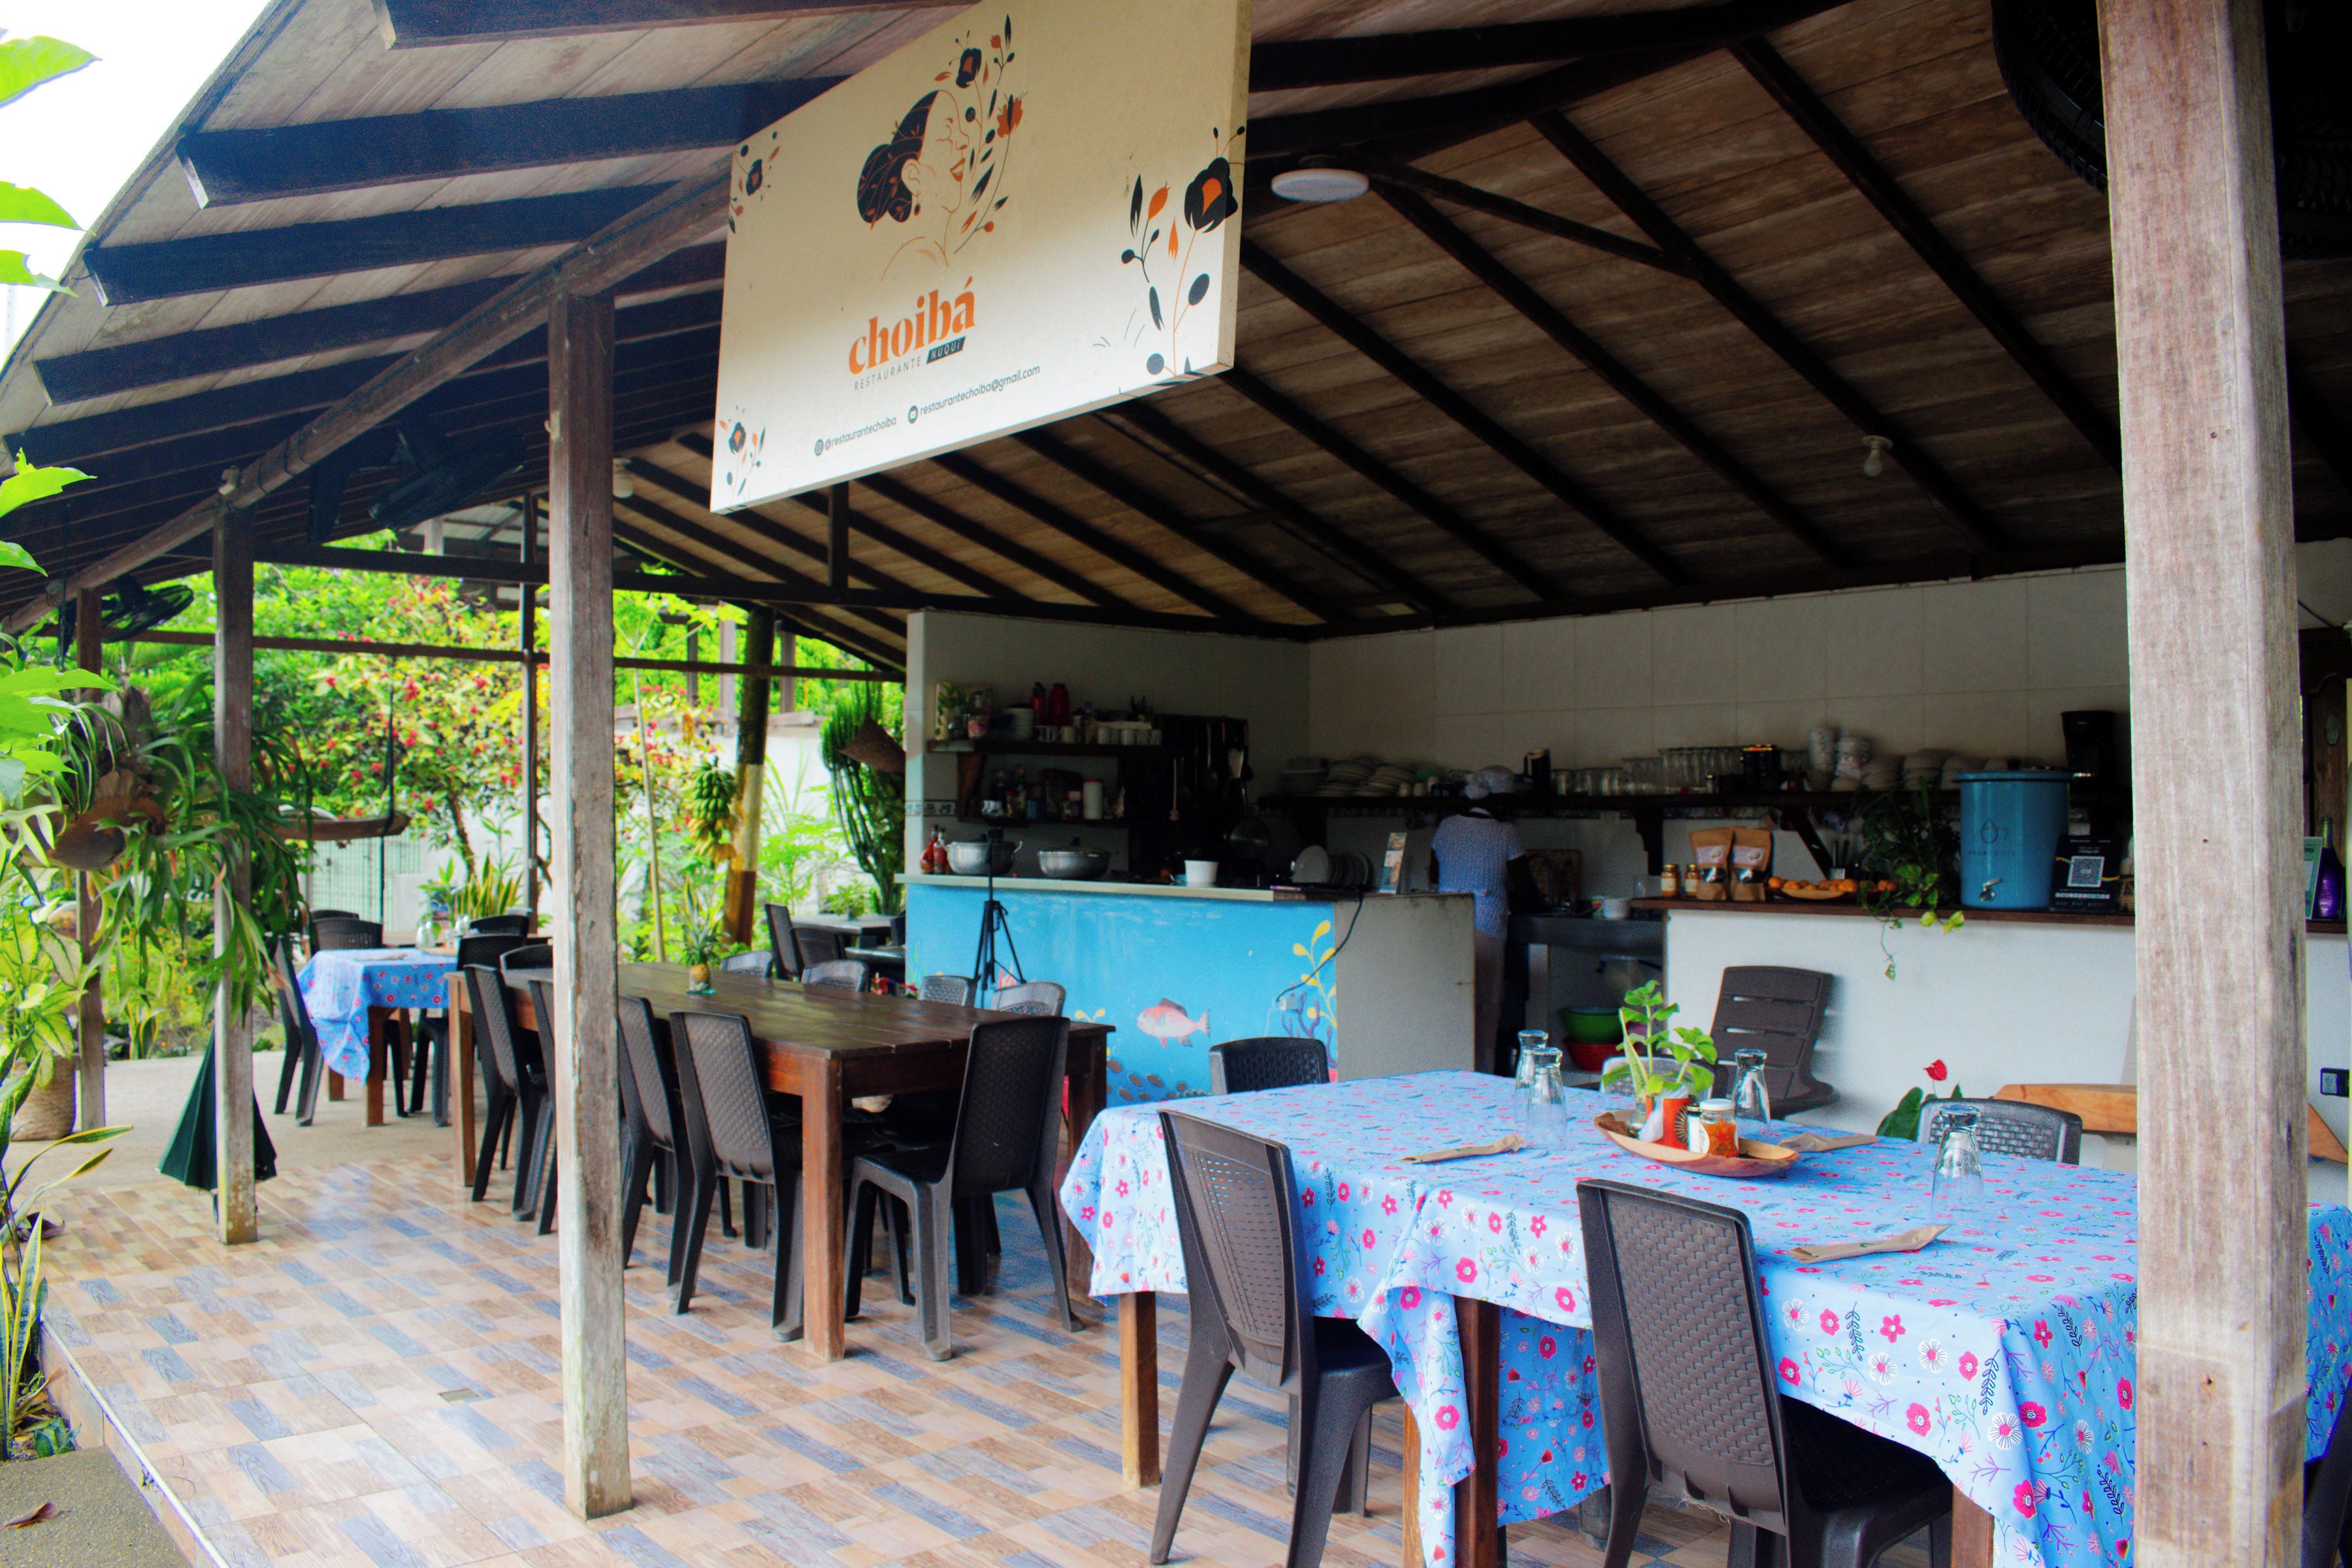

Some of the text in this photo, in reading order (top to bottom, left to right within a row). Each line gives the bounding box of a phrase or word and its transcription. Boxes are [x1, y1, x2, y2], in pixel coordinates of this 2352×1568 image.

[849, 276, 975, 374] choibá
[854, 355, 921, 391] RESTAURANTE
[919, 365, 1040, 416] restaurantechoiba@gmail.com
[825, 417, 897, 450] @restaurantechoiba
